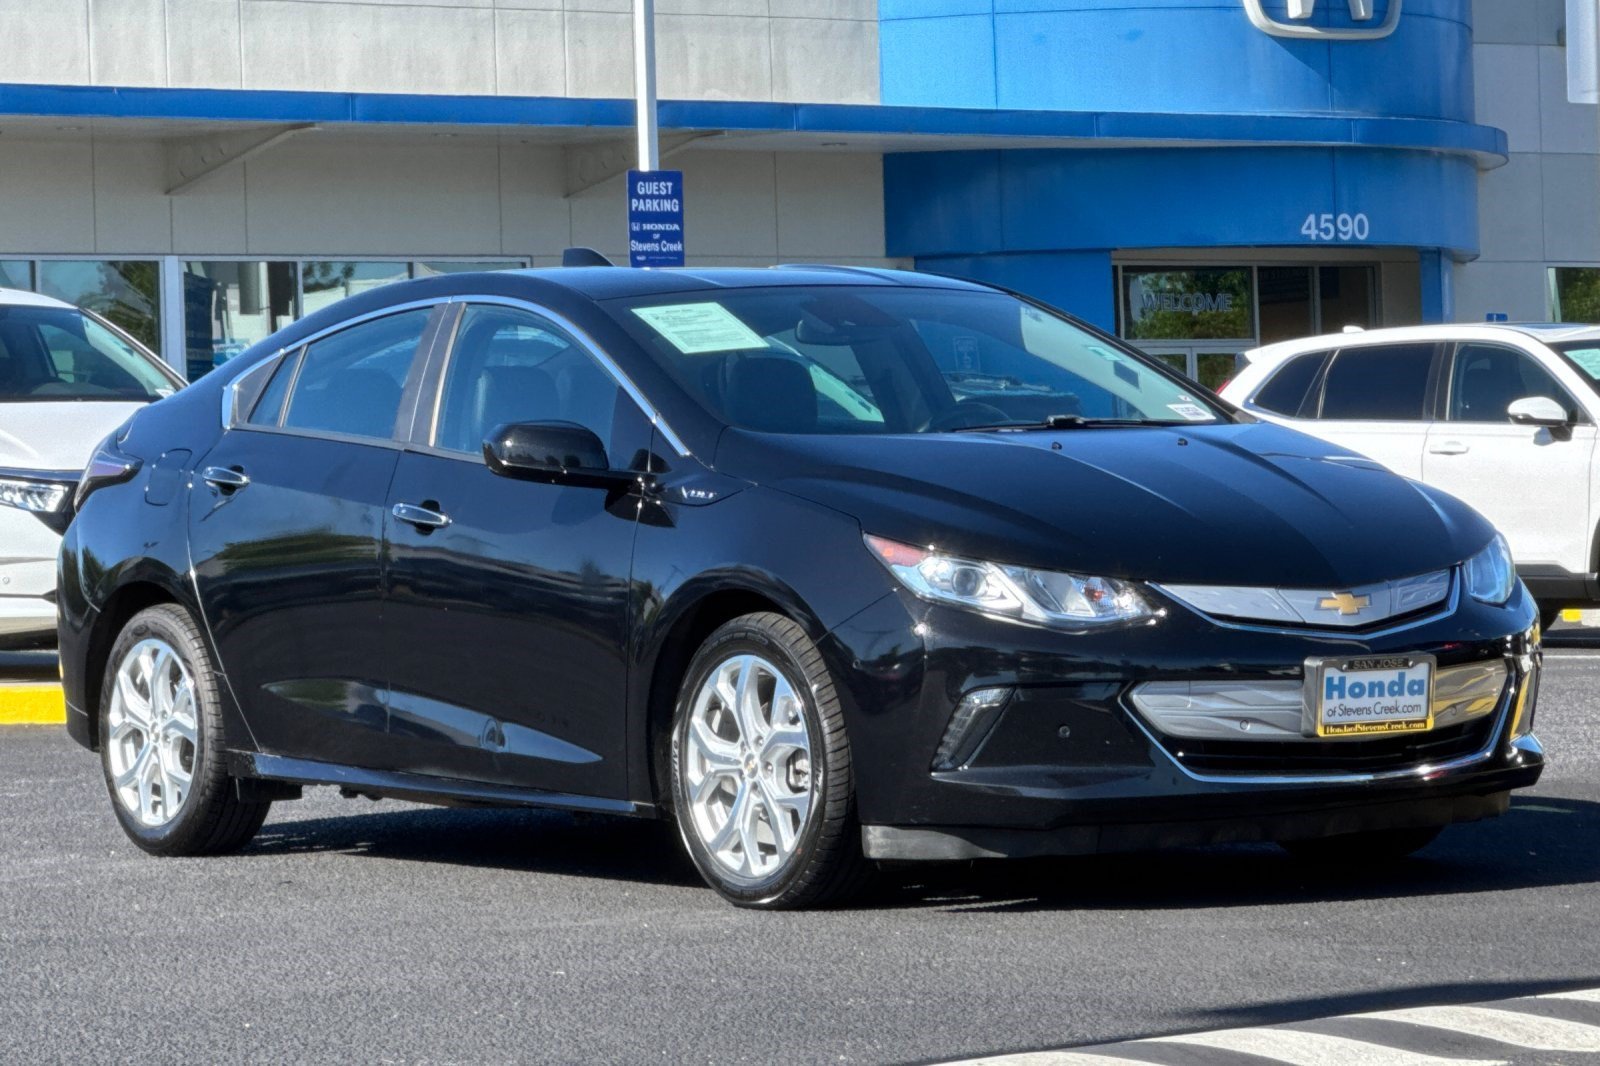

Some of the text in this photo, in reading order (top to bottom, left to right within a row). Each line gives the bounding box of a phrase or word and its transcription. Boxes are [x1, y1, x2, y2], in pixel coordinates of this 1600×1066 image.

[637, 182, 672, 194] GUEST
[631, 199, 679, 212] PARKING
[642, 223, 680, 231] HONDA
[1301, 213, 1370, 240] 4590
[630, 240, 683, 252] Stevens Creek
[1141, 293, 1233, 312] WELCOME
[1353, 658, 1404, 669] SAN JOSE
[1325, 671, 1425, 700] Honda
[1327, 707, 1337, 717] of
[1338, 703, 1372, 717] Stevens
